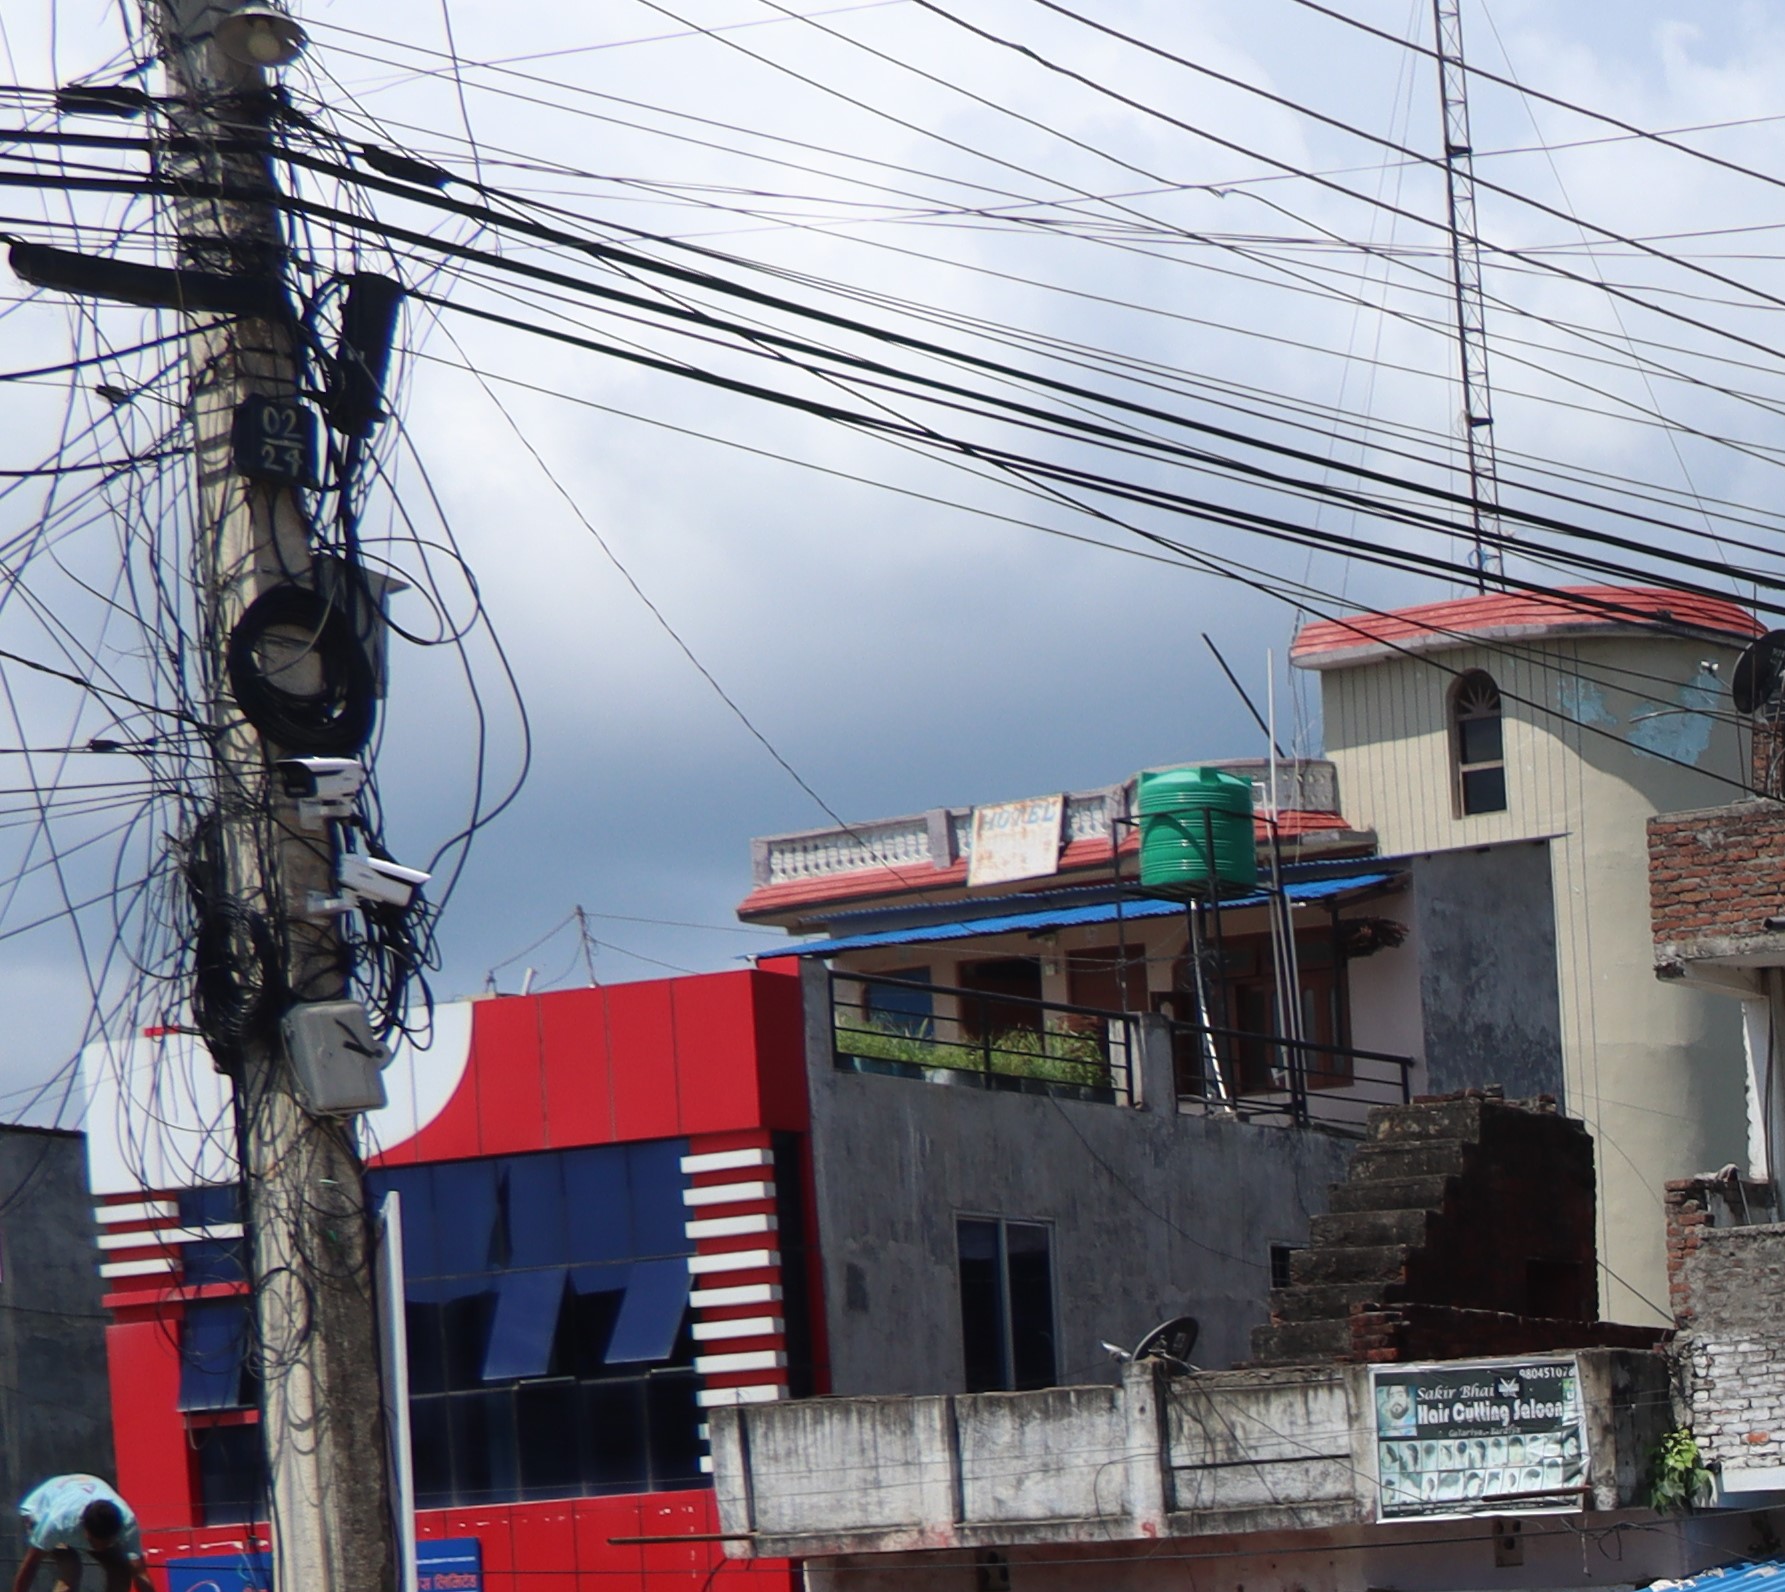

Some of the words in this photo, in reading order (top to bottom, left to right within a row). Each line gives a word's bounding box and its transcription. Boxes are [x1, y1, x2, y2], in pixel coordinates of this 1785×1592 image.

[262, 405, 303, 439] 02
[984, 802, 1056, 830] HOTEL
[1416, 1384, 1454, 1401] Sakir
[1459, 1382, 1495, 1398] Bhai
[1416, 1402, 1450, 1425] Hair
[1452, 1399, 1511, 1427] Cutting
[1513, 1398, 1563, 1420] Saloon
